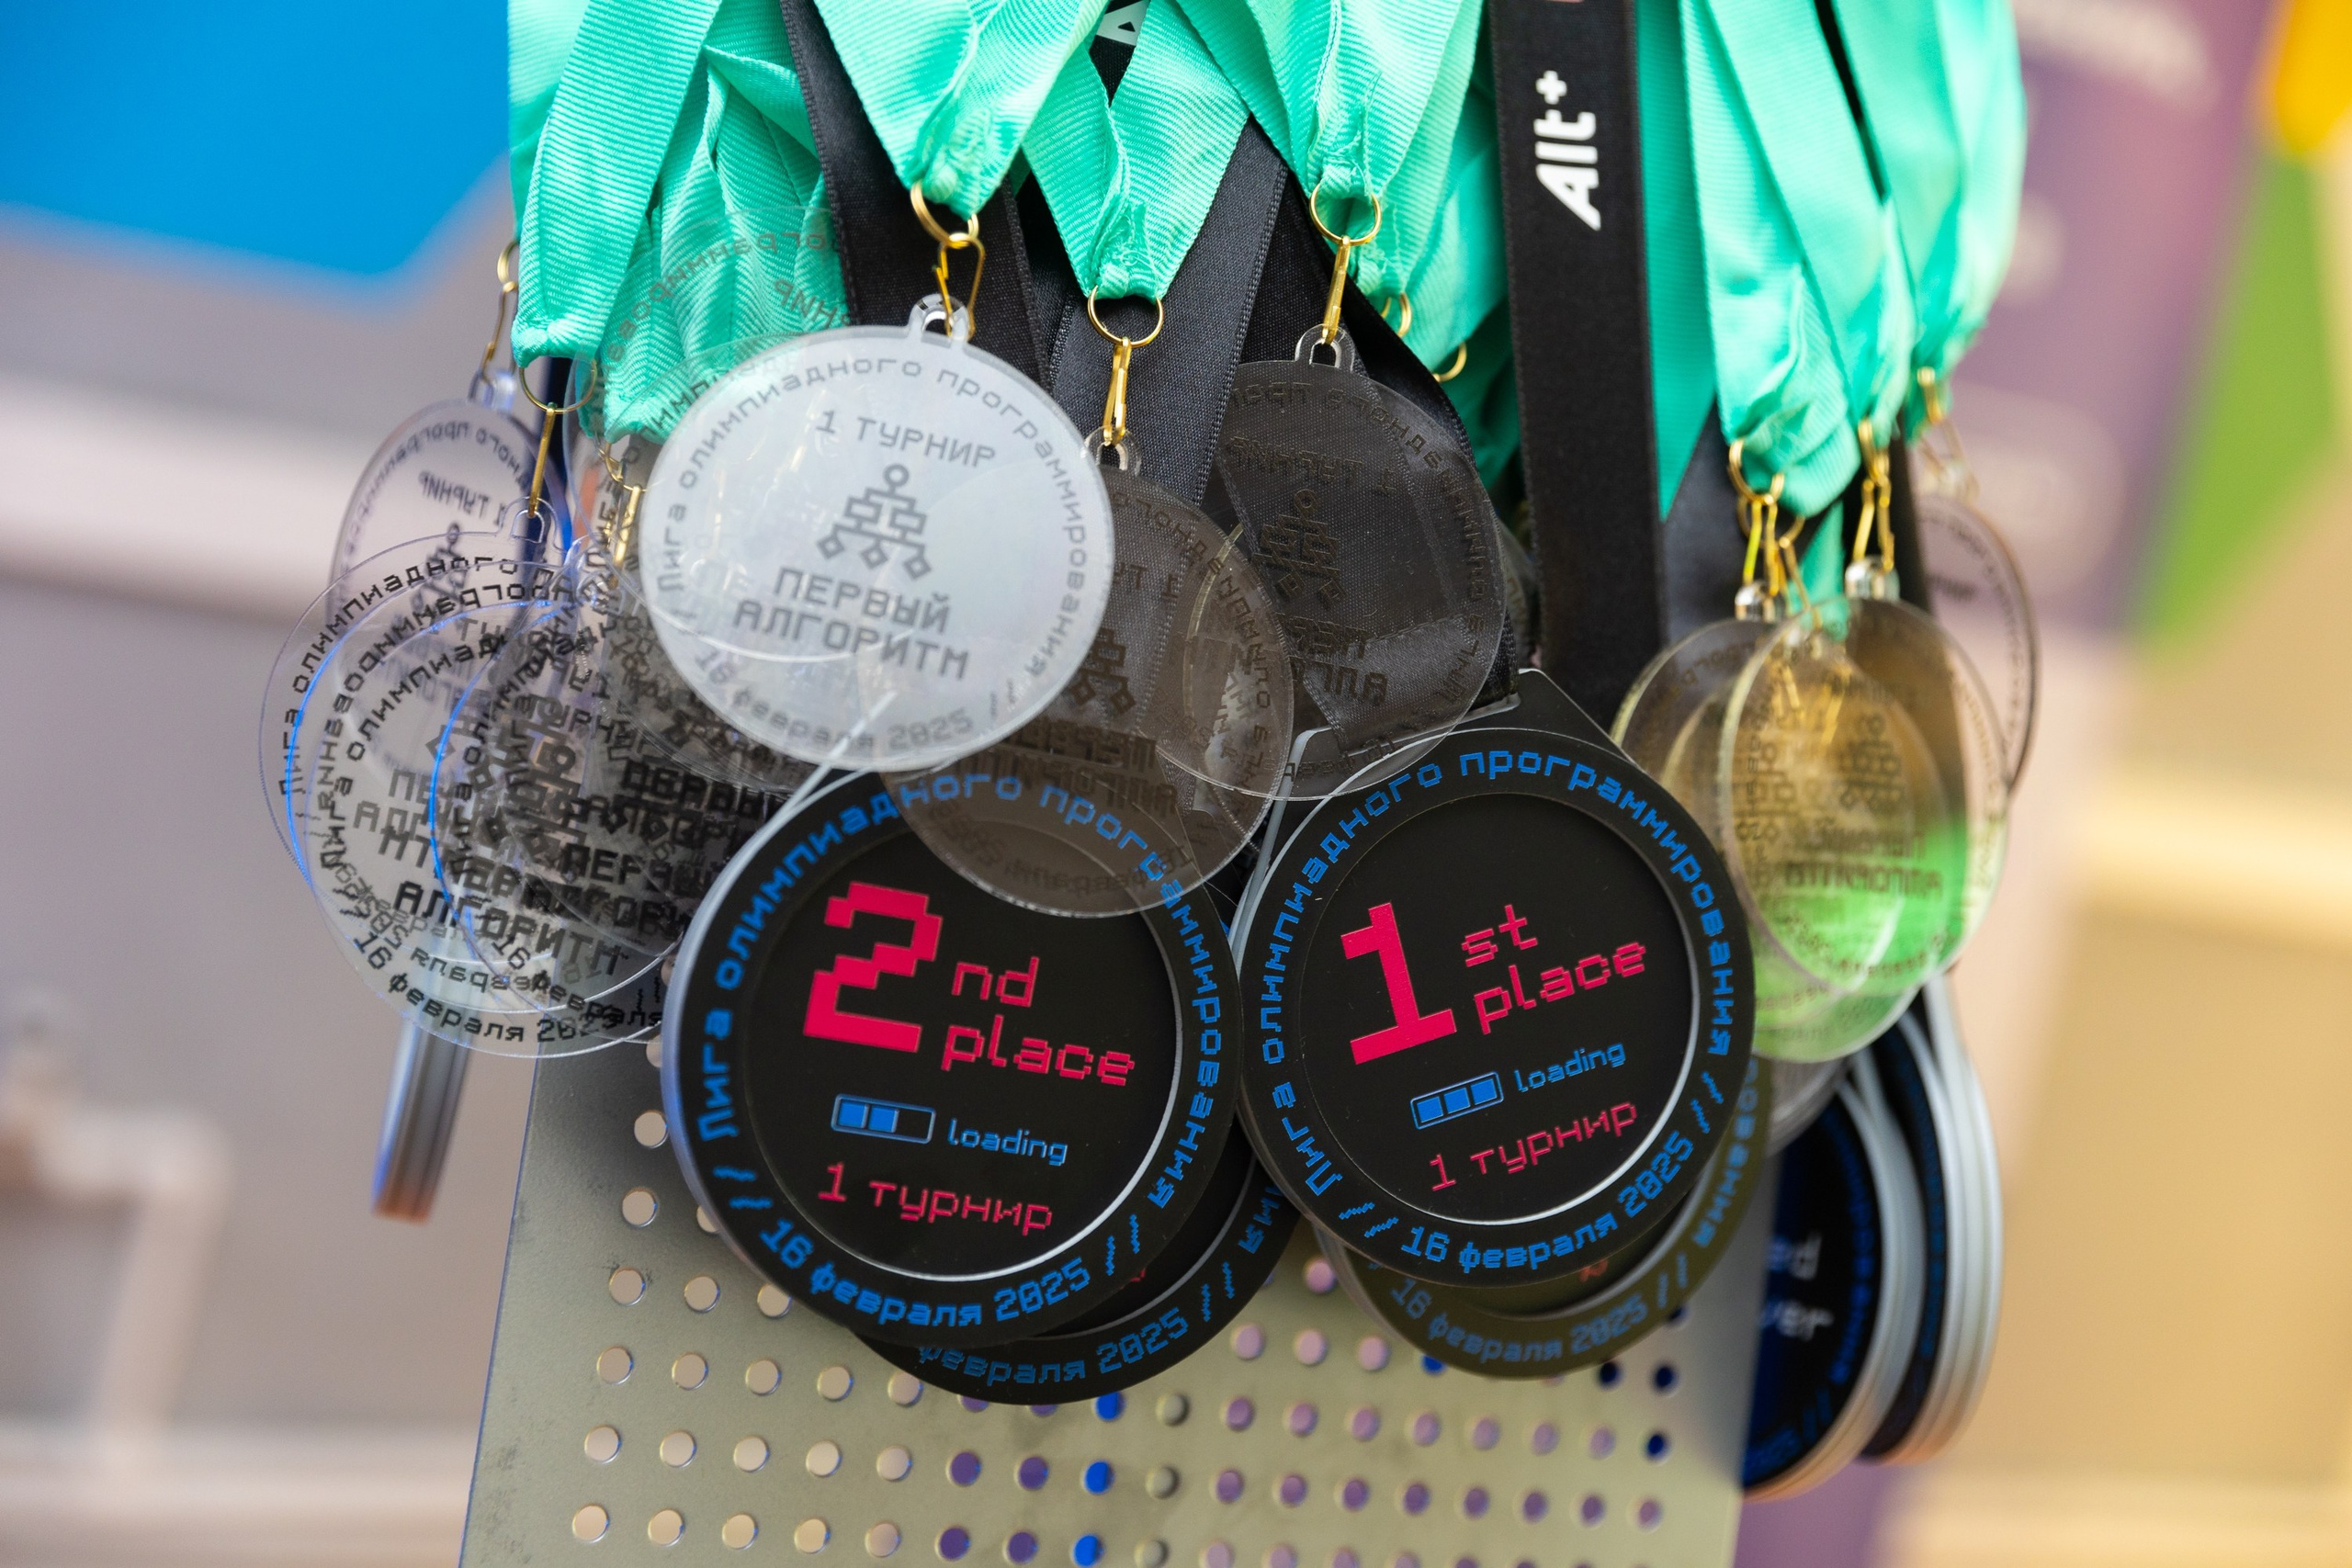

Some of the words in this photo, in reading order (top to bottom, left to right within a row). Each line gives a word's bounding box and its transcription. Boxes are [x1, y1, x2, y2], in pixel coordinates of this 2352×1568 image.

[814, 409, 838, 435] 1
[855, 415, 997, 469] ТУРНИР
[656, 503, 687, 593] Лига
[678, 356, 922, 491] олимпиадного
[936, 369, 1088, 678] программирования
[291, 556, 518, 695] олимпиадного
[732, 598, 971, 681] АЛГОРИТМ
[773, 565, 953, 636] ПЕРВЫЙ
[735, 687, 876, 751] февраля
[887, 708, 974, 752] 2025
[715, 772, 1023, 991] олимпиадного
[1261, 762, 1442, 1064] олимпиадного
[1459, 750, 1735, 1055] программирования
[352, 930, 393, 971] 16
[387, 971, 525, 1043] февраля
[1038, 784, 1223, 1210] программирования
[1473, 942, 1647, 1036] place
[696, 1009, 739, 1142] Лига
[940, 1013, 1136, 1087] place
[1513, 1043, 1627, 1093] loading
[947, 1118, 1069, 1167] loading
[1272, 1081, 1343, 1197] Лига
[1430, 1154, 1457, 1192] 1
[1470, 1101, 1638, 1175] турнир
[818, 1162, 847, 1202] 1
[869, 1179, 1053, 1237] турнир
[1401, 1225, 1450, 1263] 16
[1458, 1211, 1620, 1274] февраля
[1617, 1130, 1695, 1219] 2025
[760, 1219, 815, 1270] 16
[810, 1261, 983, 1328] февраля
[993, 1257, 1091, 1323] 2025
[1096, 1306, 1190, 1374] 2025
[1428, 1312, 1563, 1364] февраля
[1569, 1293, 1649, 1355] 2025
